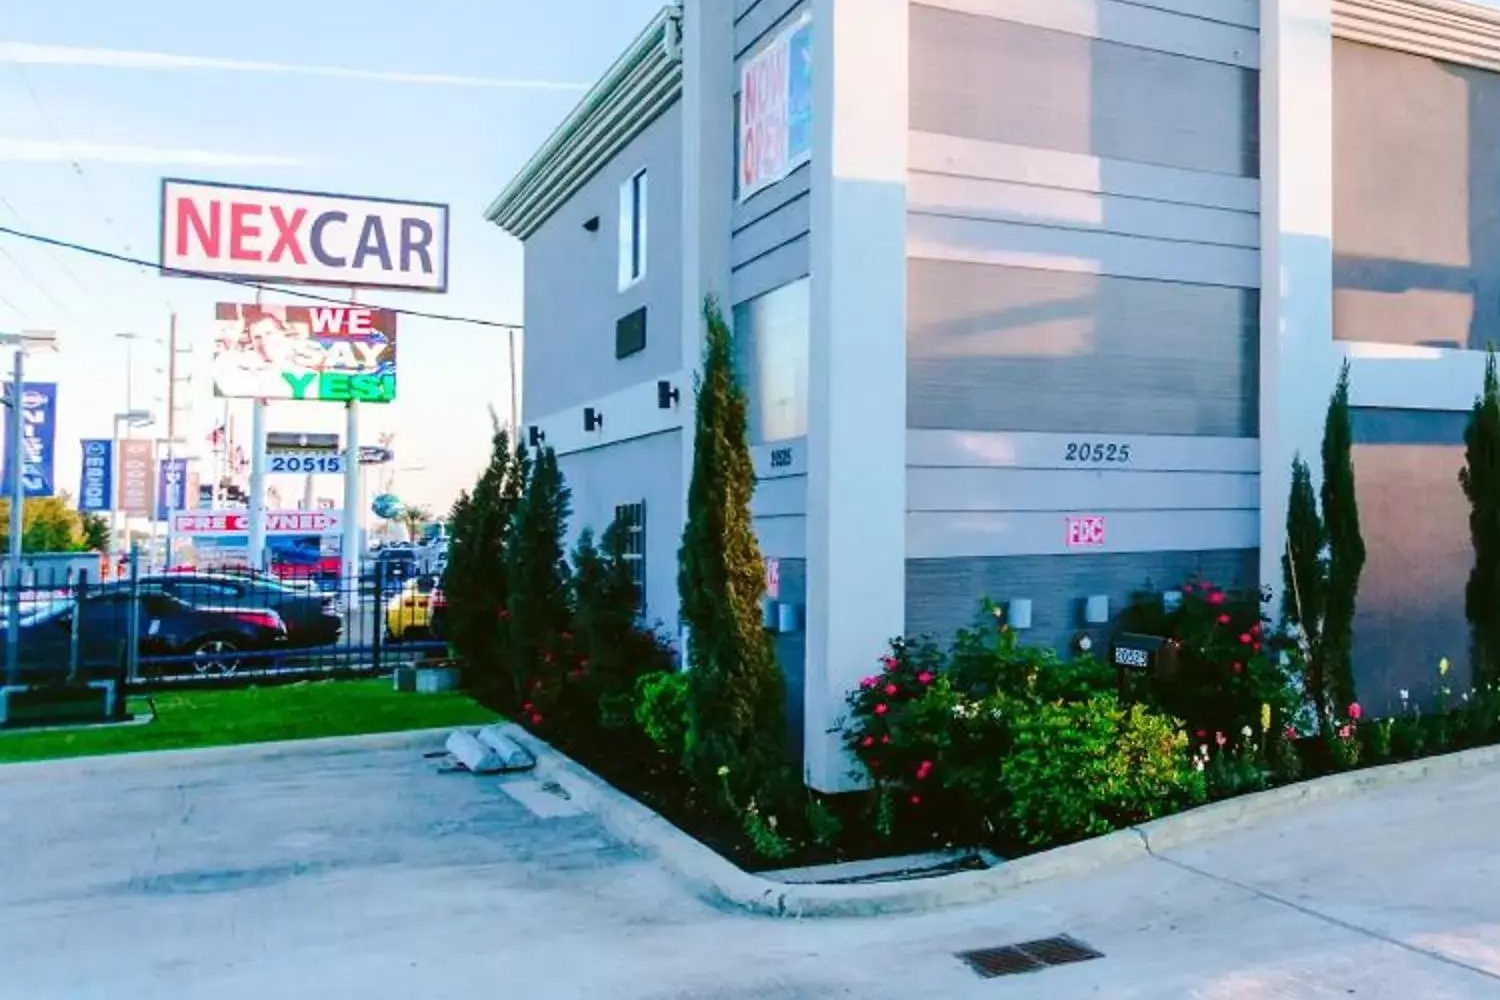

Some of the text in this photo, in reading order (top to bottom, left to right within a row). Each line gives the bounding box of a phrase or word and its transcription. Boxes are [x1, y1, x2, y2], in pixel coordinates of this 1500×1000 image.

[176, 197, 433, 274] NEXCAR
[309, 307, 372, 334] WE
[297, 340, 387, 367] SAY
[281, 371, 396, 402] YES!
[272, 457, 340, 472] 20515
[1065, 442, 1130, 462] 20525
[177, 515, 226, 530] PRE
